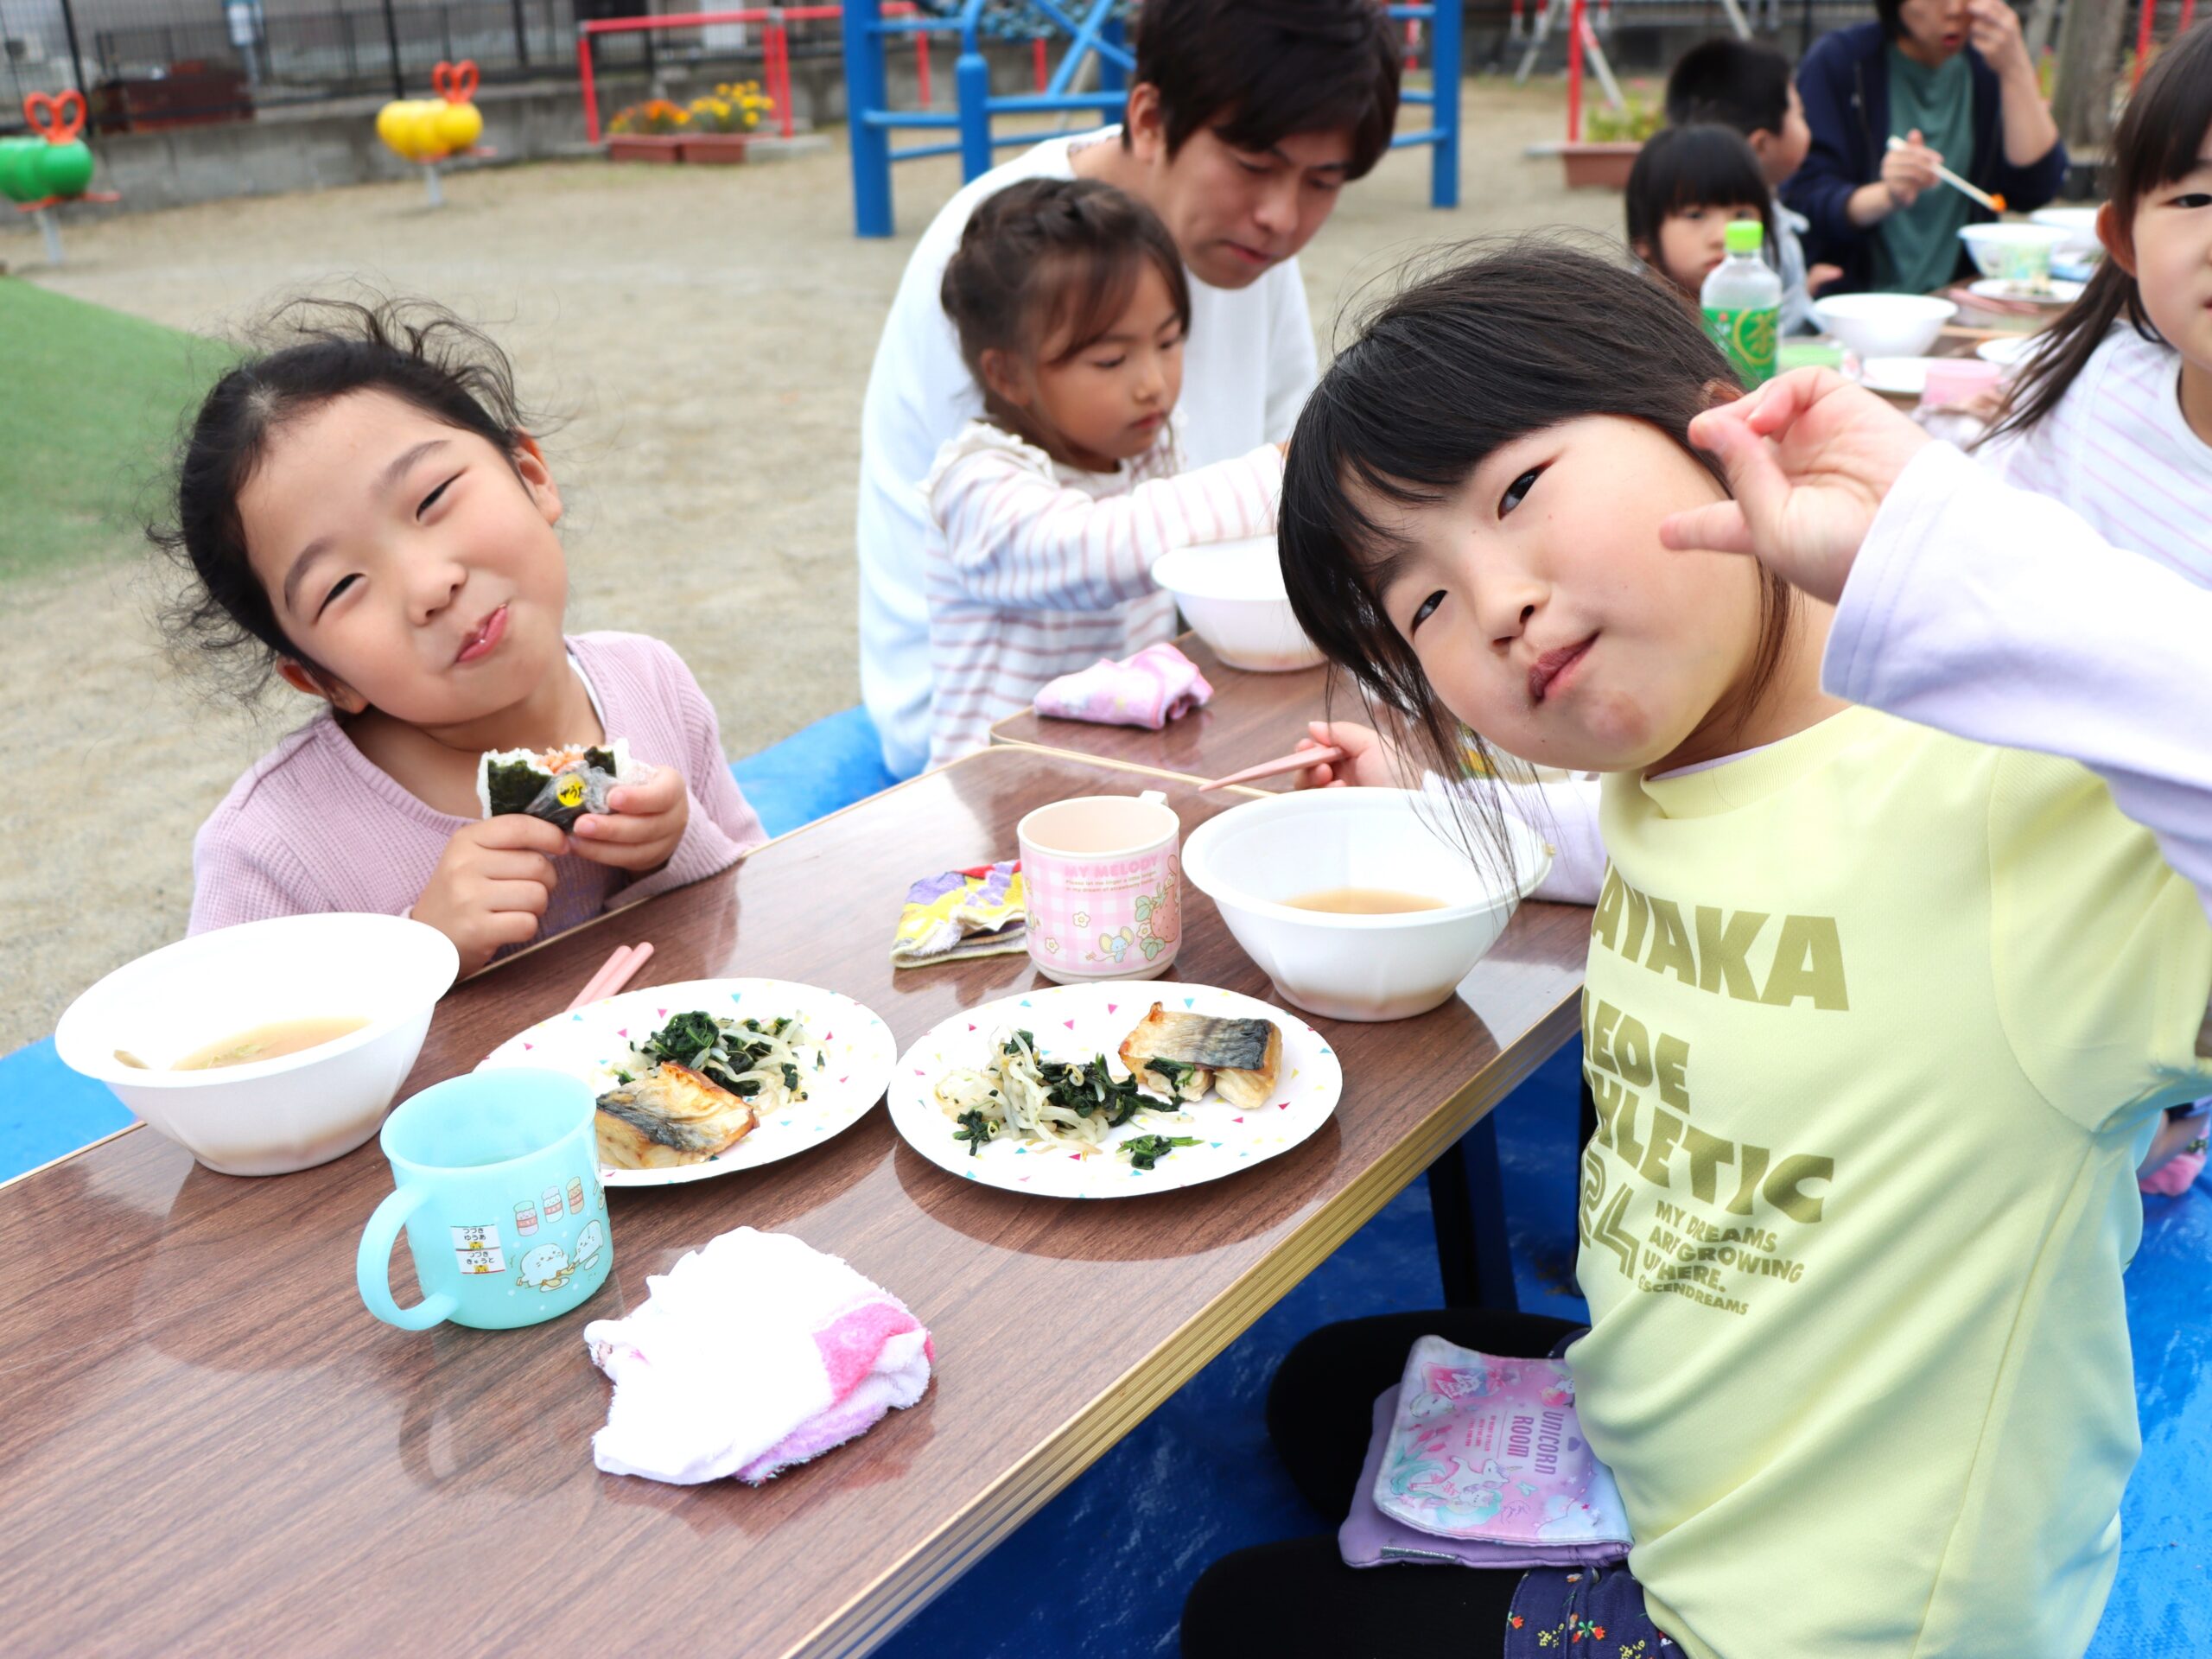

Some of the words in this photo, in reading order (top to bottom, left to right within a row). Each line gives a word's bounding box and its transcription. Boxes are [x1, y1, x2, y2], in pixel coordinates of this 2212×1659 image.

[1064, 865, 1090, 878] MY
[1094, 855, 1158, 878] MELODY
[1591, 855, 1850, 1012] AYAKA
[1655, 1199, 1687, 1229] MY
[1686, 1215, 1777, 1254] DREAMS
[1656, 1262, 1726, 1294] HERE.
[1676, 1242, 1805, 1283] GROWING
